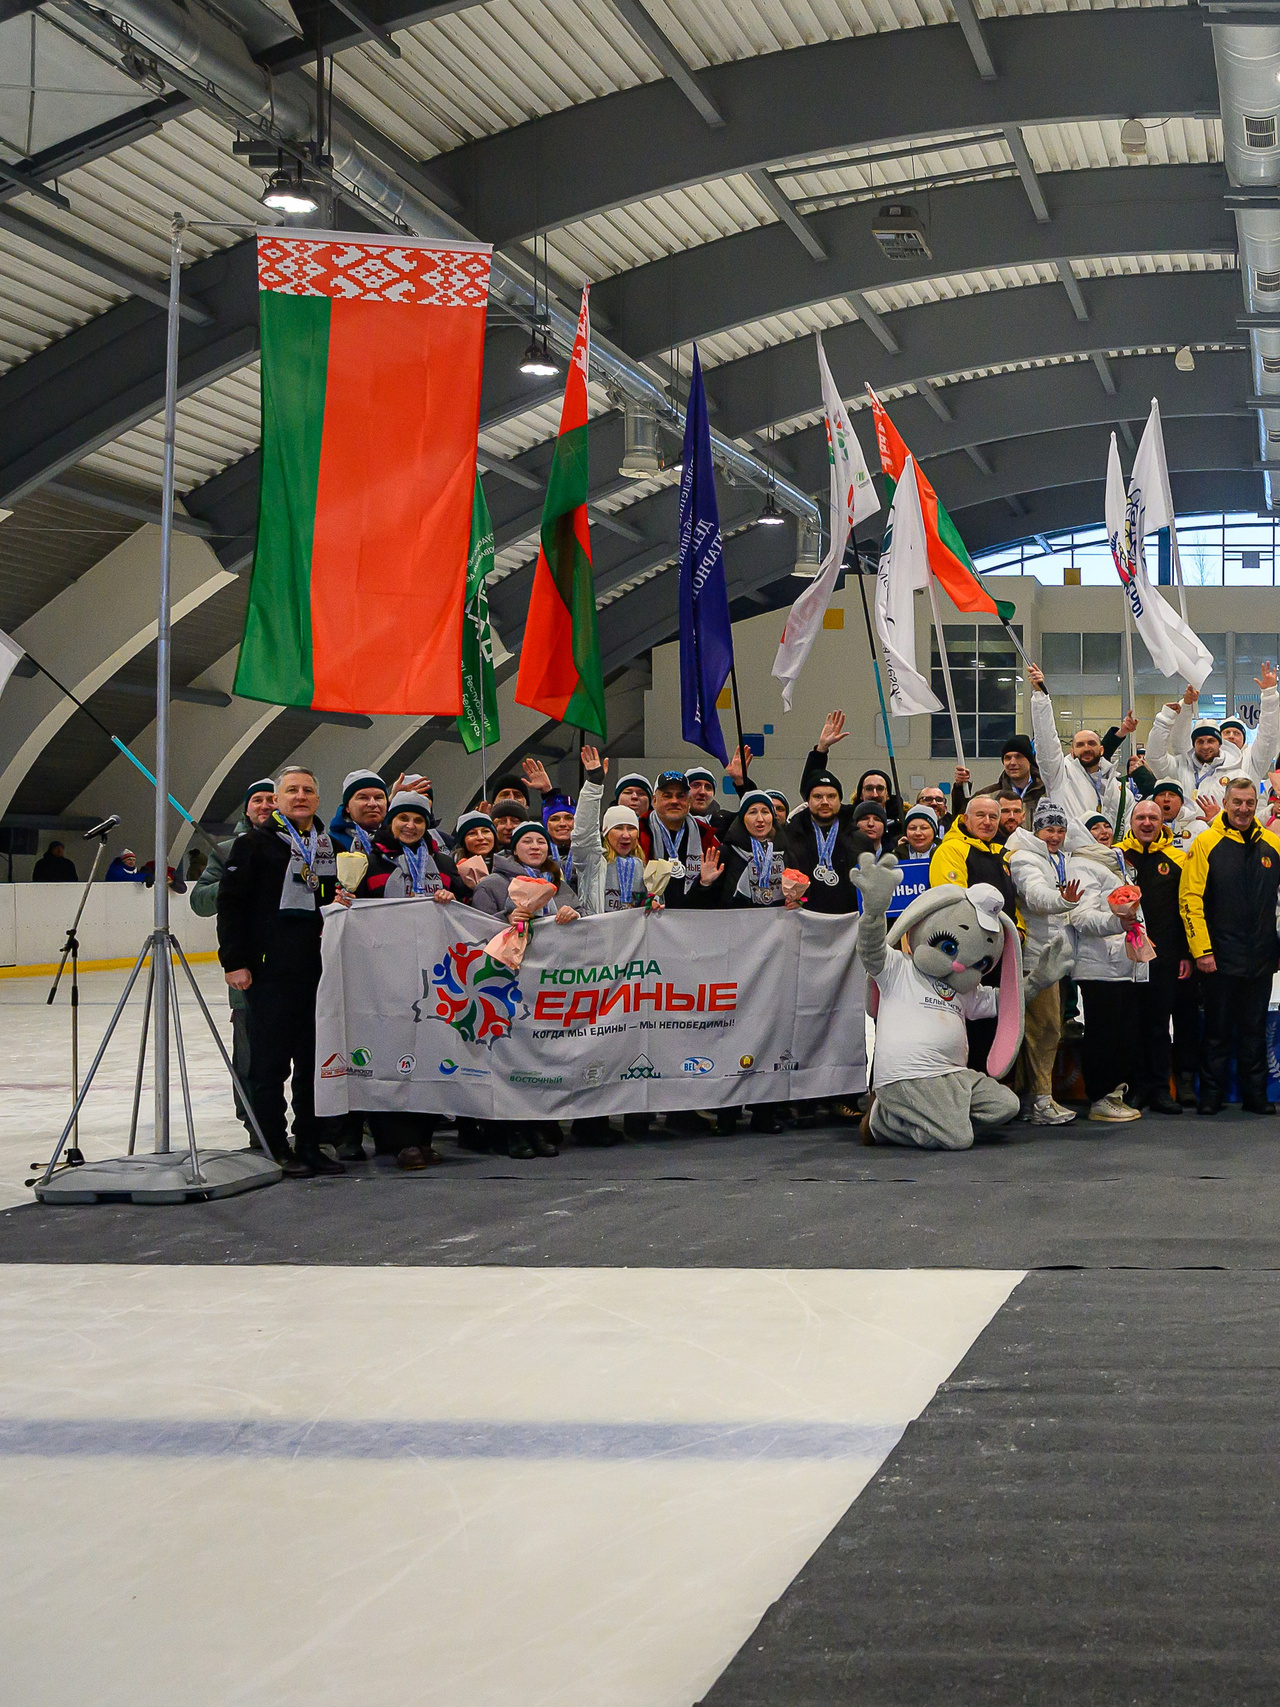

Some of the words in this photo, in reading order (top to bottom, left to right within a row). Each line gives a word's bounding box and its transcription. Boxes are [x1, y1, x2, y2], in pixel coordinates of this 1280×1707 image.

[892, 883, 926, 897] ные
[540, 960, 662, 985] КОМАНДА
[534, 982, 738, 1027] ЕДИНЫЕ
[532, 1030, 565, 1039] КОГДА
[567, 1028, 587, 1038] МЫ
[590, 1024, 627, 1036] ЕДИНЫ
[640, 1021, 657, 1030] МЫ
[659, 1019, 736, 1030] НЕПОБЕДИМЫ!
[509, 1075, 563, 1084] ВОСТОЧНЫЙ
